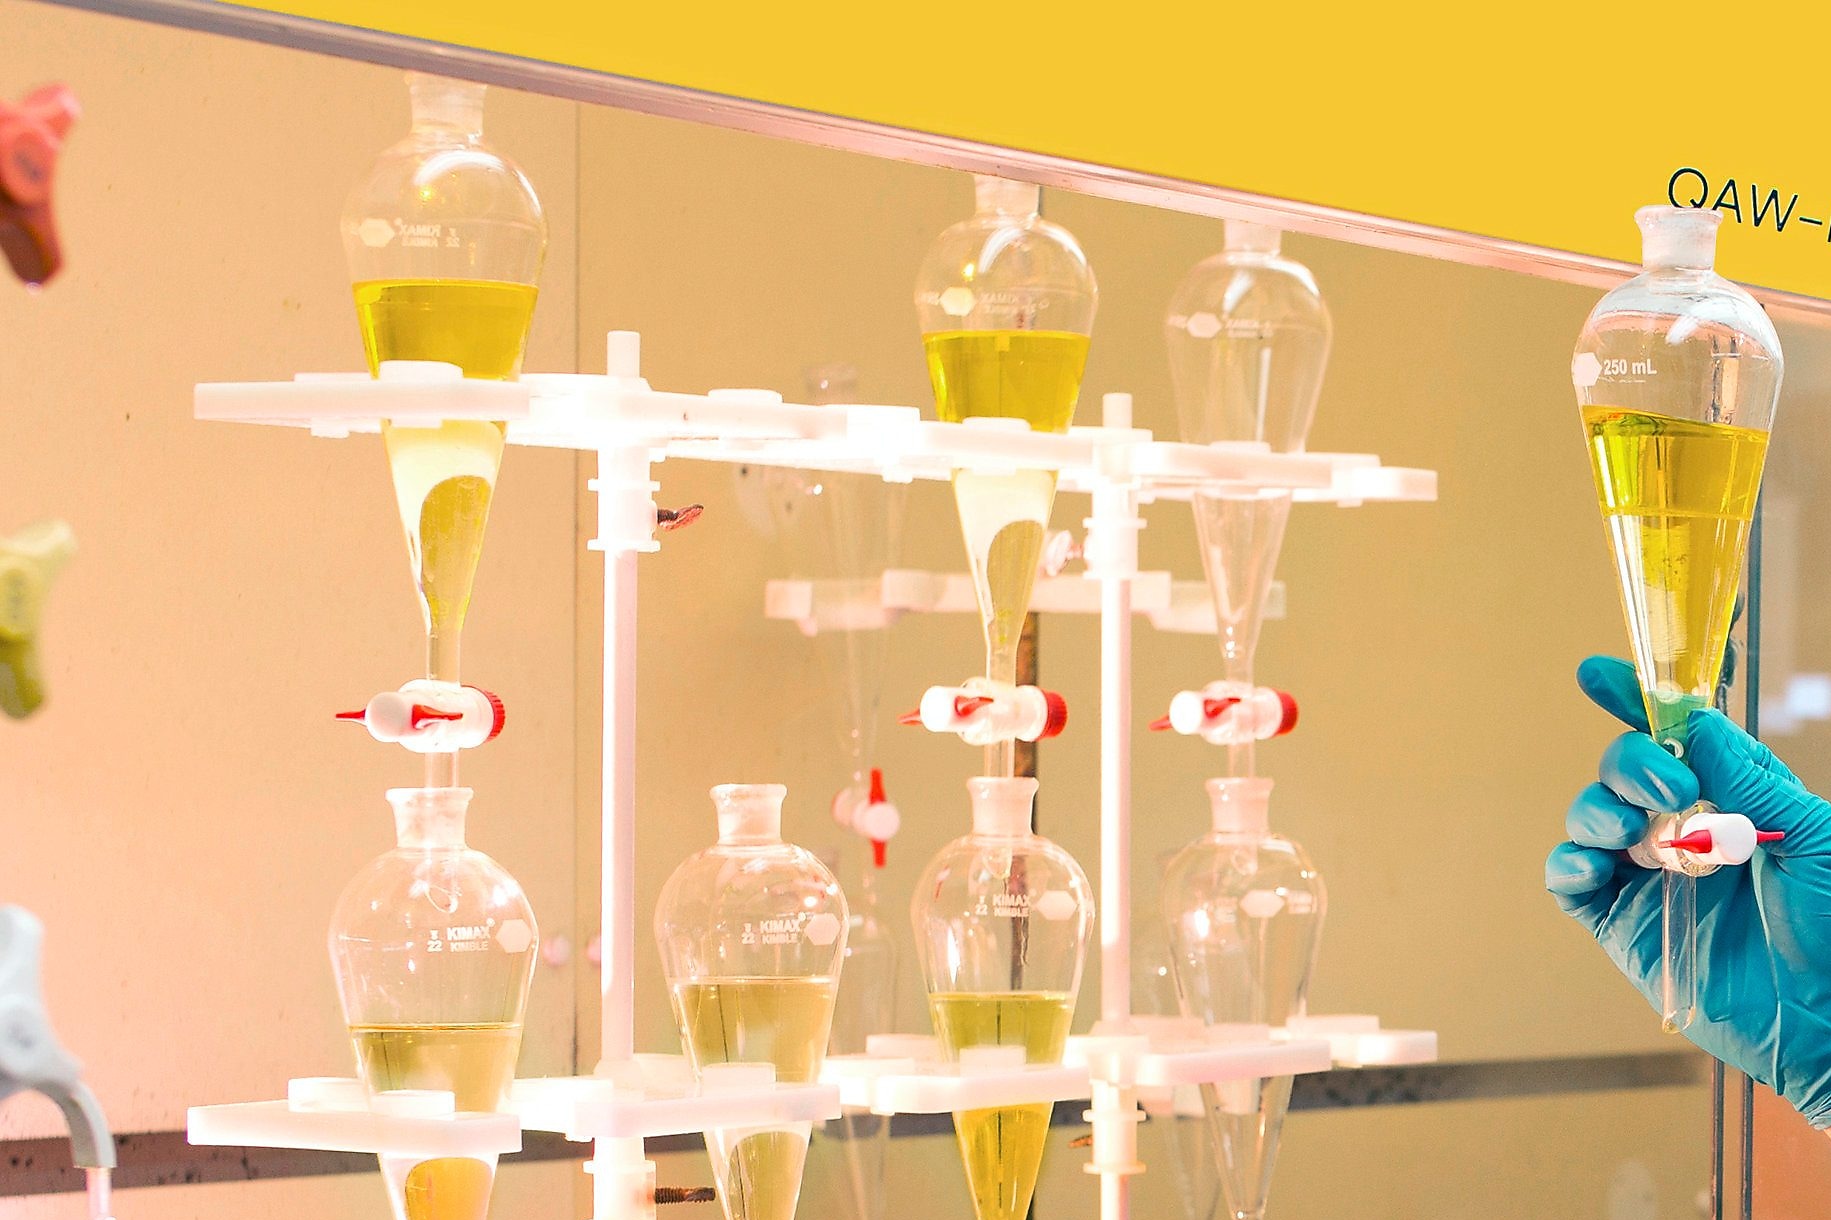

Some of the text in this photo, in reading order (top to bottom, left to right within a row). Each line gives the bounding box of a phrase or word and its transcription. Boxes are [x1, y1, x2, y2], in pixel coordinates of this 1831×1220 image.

[1603, 357, 1658, 375] 250 mL
[993, 893, 1029, 907] KIMAX
[446, 926, 490, 941] KIMAX
[760, 919, 801, 934] KIMAX
